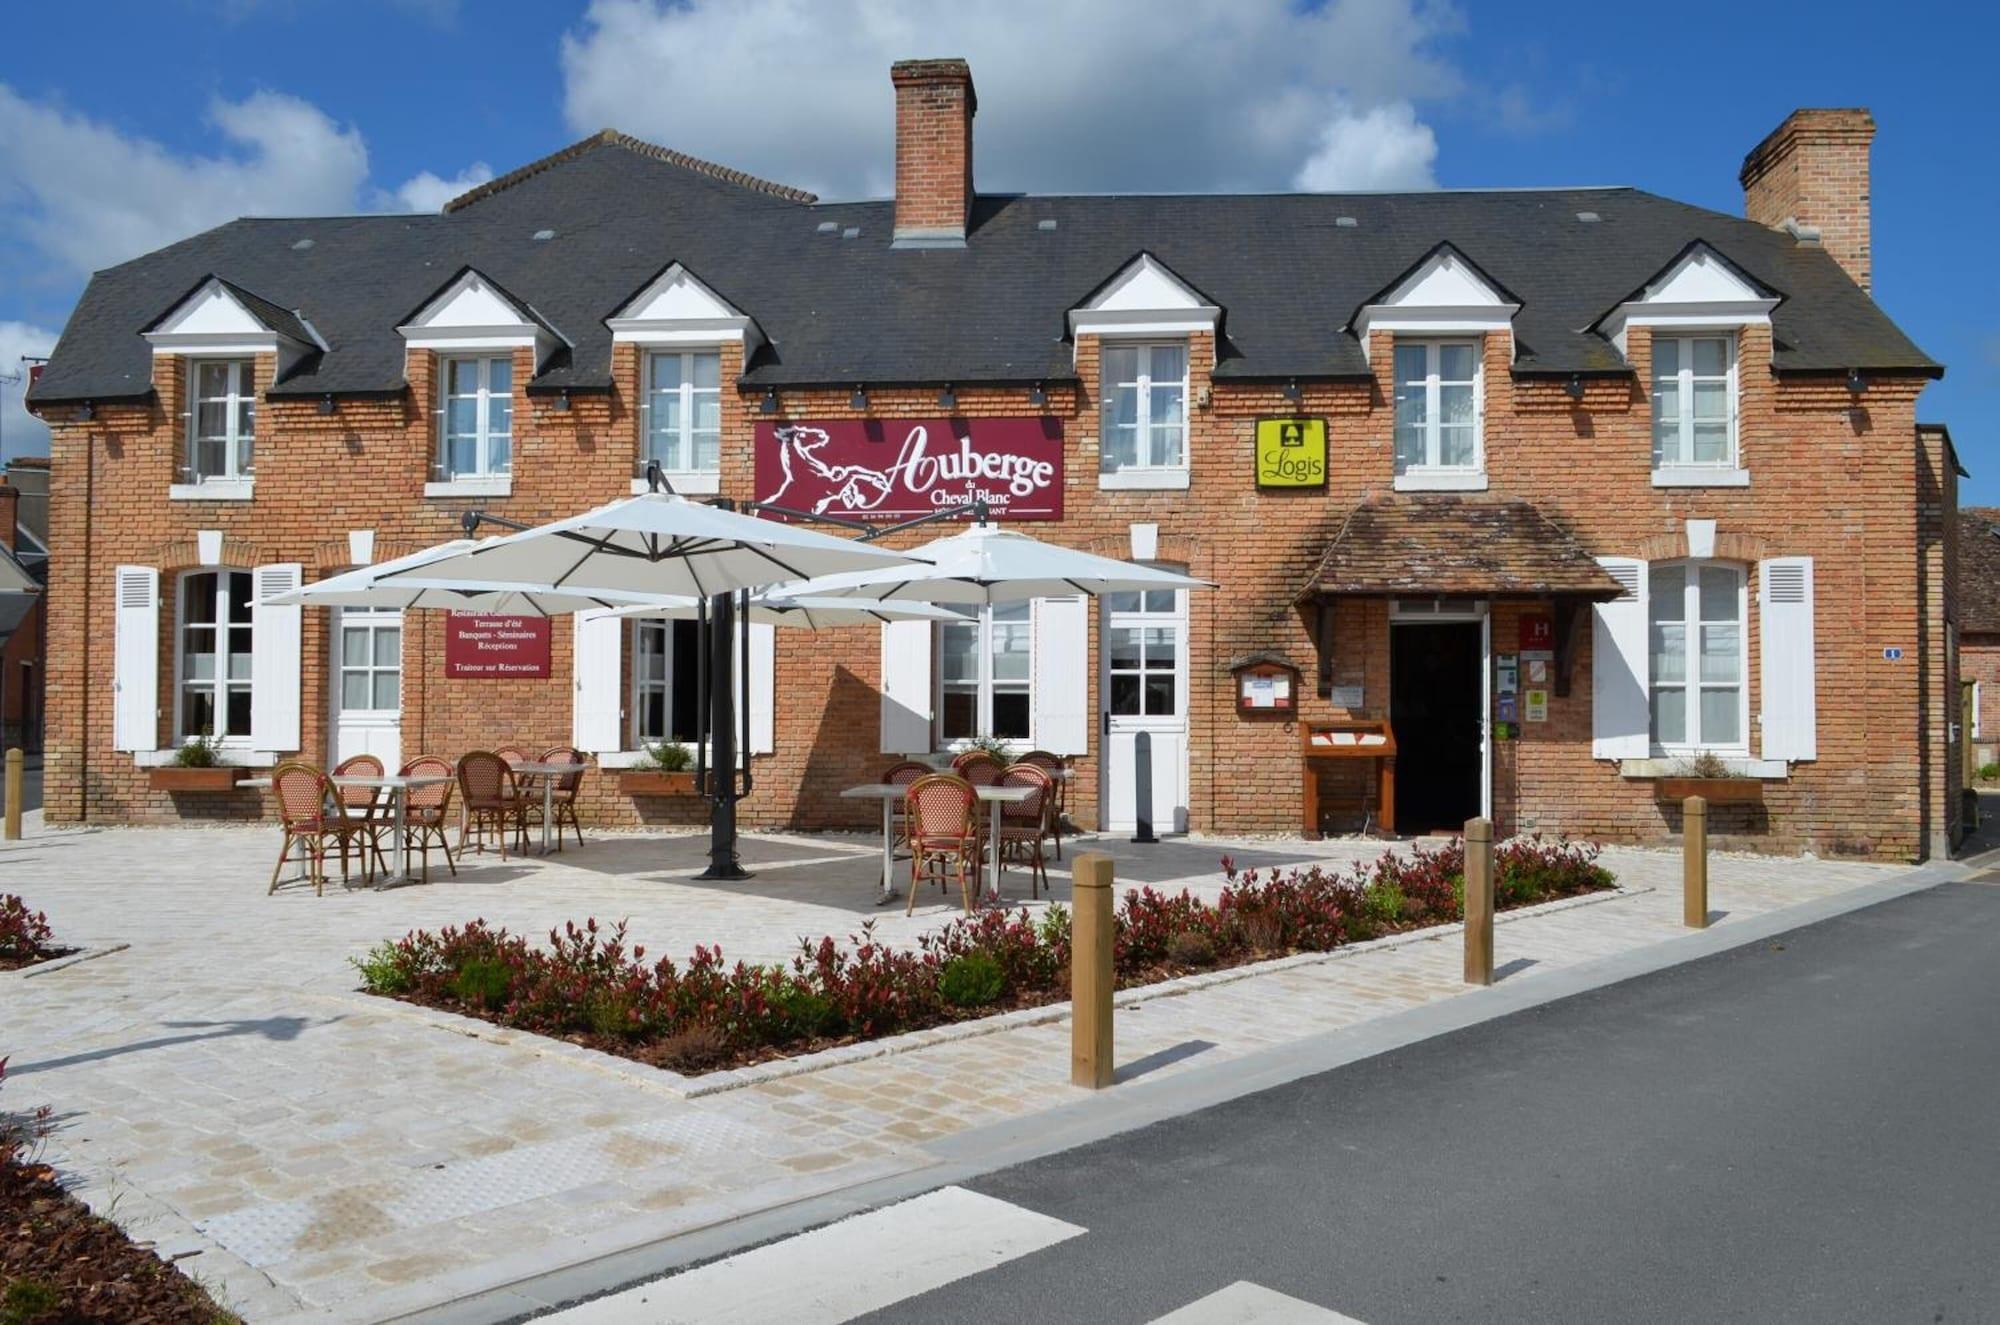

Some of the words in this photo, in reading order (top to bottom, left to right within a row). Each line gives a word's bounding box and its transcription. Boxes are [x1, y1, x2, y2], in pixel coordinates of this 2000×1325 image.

[885, 425, 1054, 496] Auberge
[1262, 448, 1322, 482] Logis
[965, 480, 976, 489] du
[930, 489, 973, 505] Cheval
[976, 489, 1011, 504] Blanc
[1535, 623, 1548, 636] H
[478, 641, 517, 650] Réceptions
[455, 663, 484, 672] Traiteur
[485, 664, 497, 672] sur
[498, 663, 540, 672] Réservation
